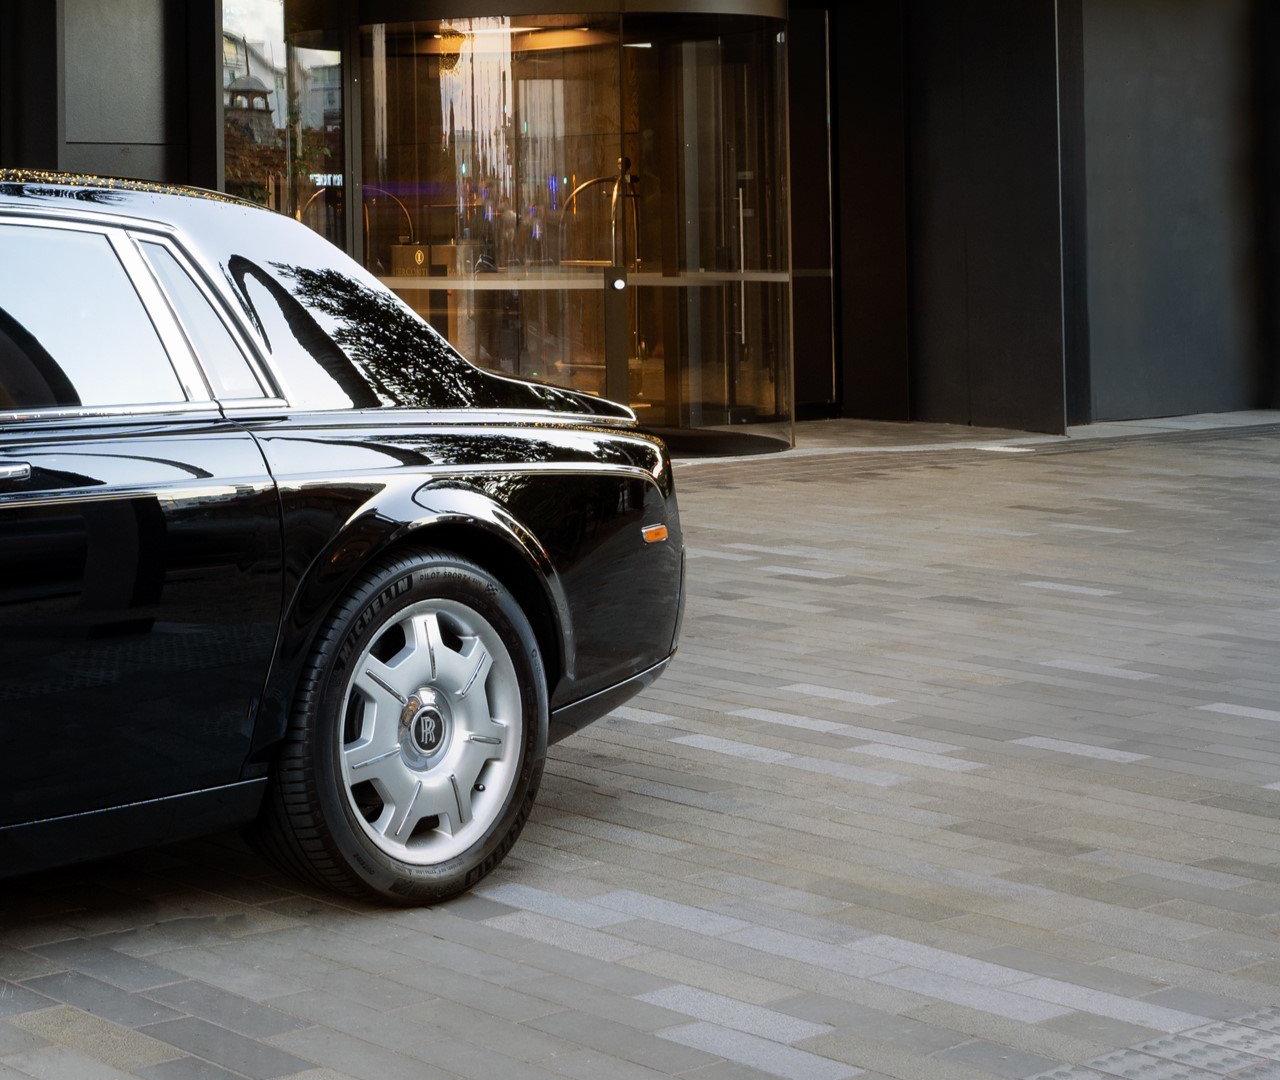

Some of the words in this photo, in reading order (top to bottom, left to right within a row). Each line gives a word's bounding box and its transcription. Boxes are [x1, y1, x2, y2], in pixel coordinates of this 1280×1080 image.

[338, 575, 411, 663] MICHELIN
[419, 571, 441, 581] PILOT
[443, 570, 467, 580] SPORT
